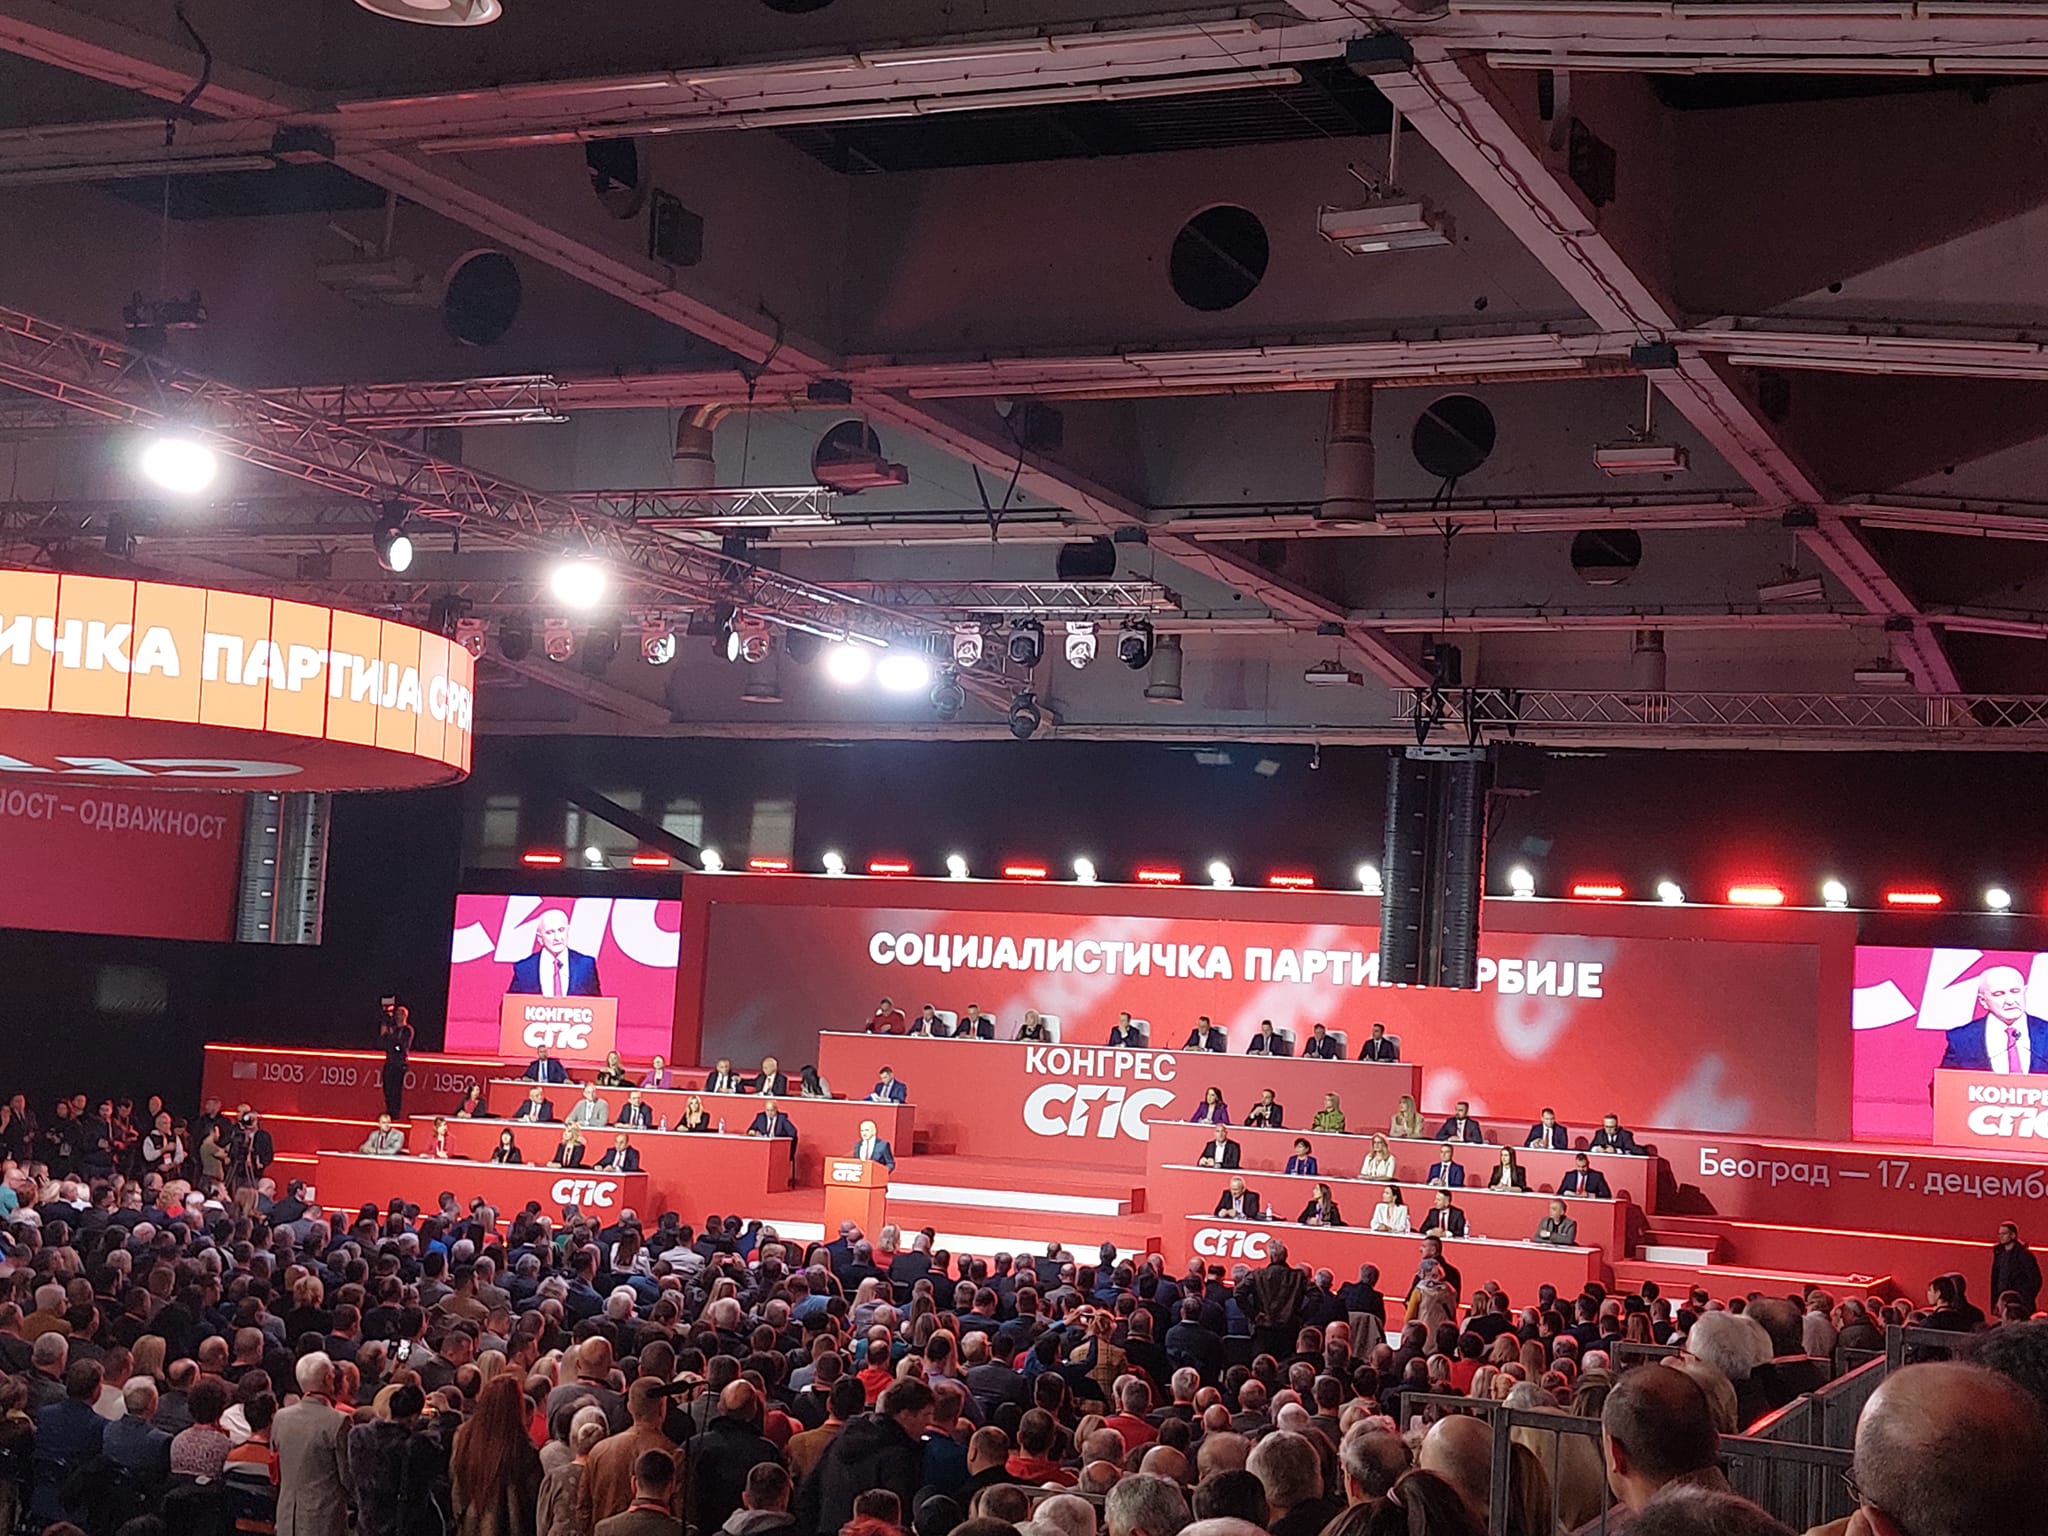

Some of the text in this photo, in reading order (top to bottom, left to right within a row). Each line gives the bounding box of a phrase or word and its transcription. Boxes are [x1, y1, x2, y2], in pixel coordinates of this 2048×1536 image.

[203, 632, 422, 714] ПАРТИЈА
[869, 932, 1604, 998] СОЦИЈАЛИСТИЧКА ПАРТИ РБИЈЕ
[524, 1006, 593, 1023] КОНГРЕС
[523, 1022, 592, 1049] СПС
[262, 1063, 303, 1082] 1903
[320, 1066, 357, 1086] 1919
[1025, 1046, 1176, 1081] КОНГРЕС
[1024, 1083, 1176, 1141] СПС
[1700, 1147, 1830, 1188] Београд
[1877, 1160, 1915, 1190] 17.
[551, 1179, 618, 1207] СПС
[1193, 1228, 1271, 1259] СПС
